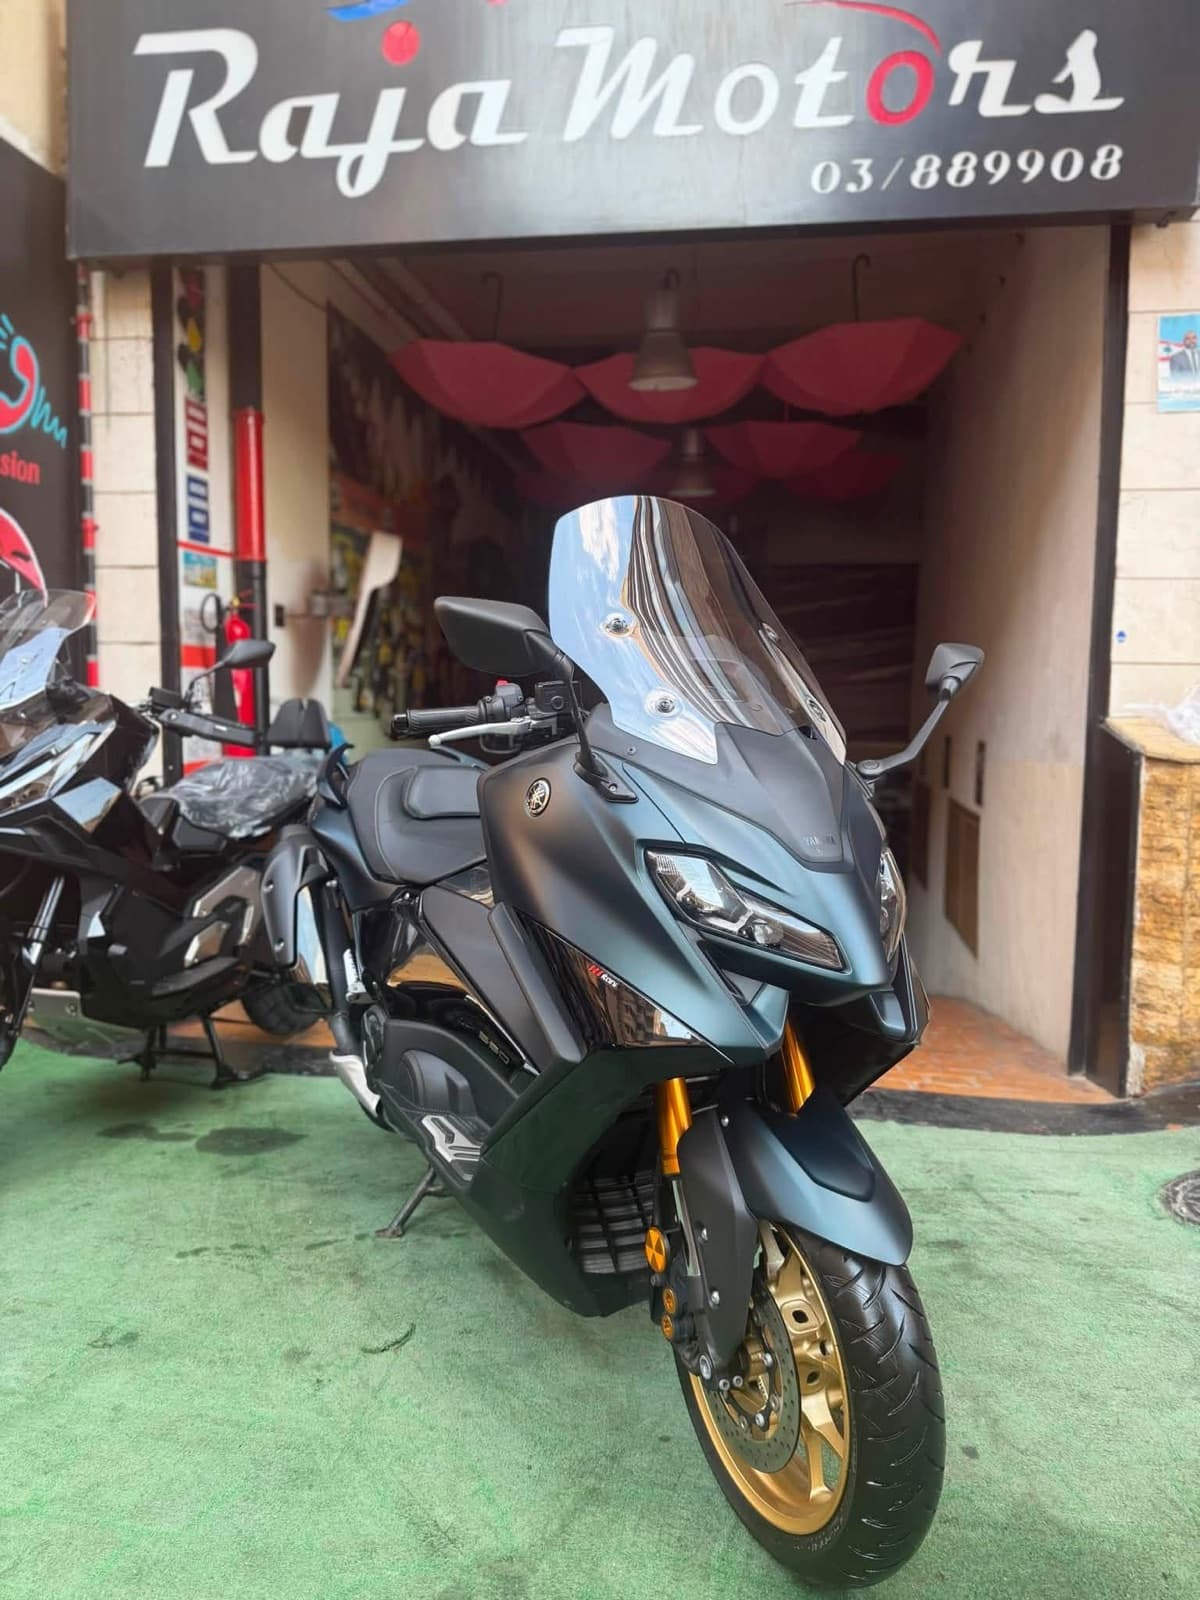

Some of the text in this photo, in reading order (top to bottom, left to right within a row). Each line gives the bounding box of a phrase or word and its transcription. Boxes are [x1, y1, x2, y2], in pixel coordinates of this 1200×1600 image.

[133, 21, 1125, 198] Raja Motors
[810, 144, 1125, 194] 03/889908
